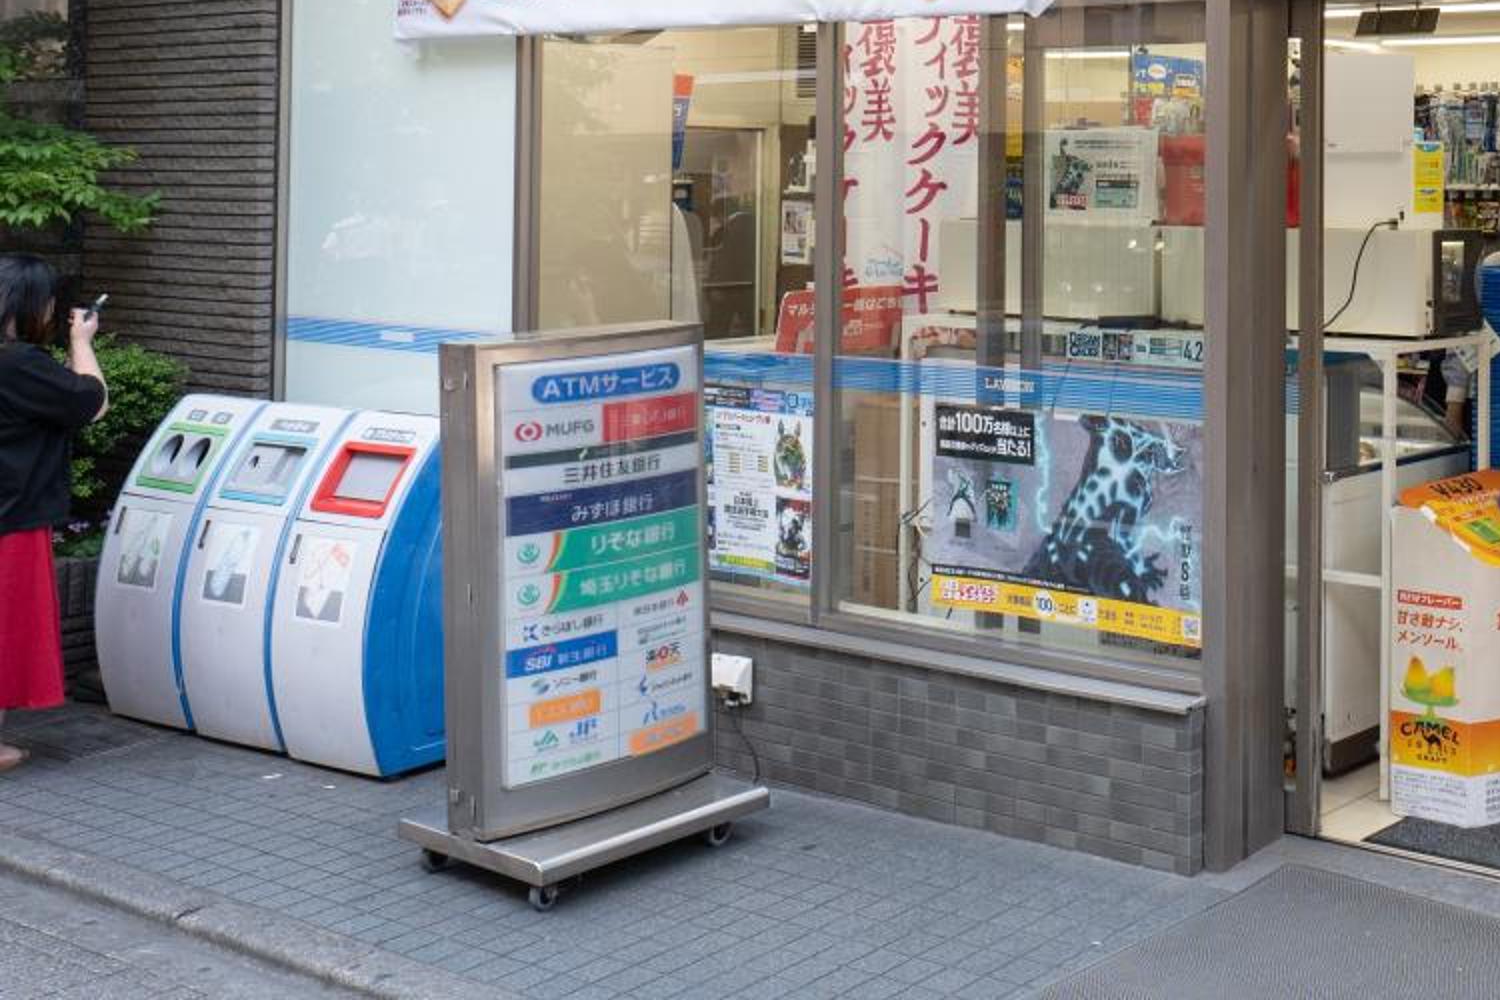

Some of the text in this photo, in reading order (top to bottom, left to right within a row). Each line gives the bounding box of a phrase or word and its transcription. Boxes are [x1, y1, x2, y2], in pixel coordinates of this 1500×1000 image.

[543, 366, 673, 400] ATMサービス
[546, 420, 595, 438] MUFG
[563, 453, 662, 484] 三井住友銀行
[570, 493, 654, 522] みずほ銀行
[590, 520, 675, 555] りそな銀行
[1400, 722, 1461, 747] CAMEL
